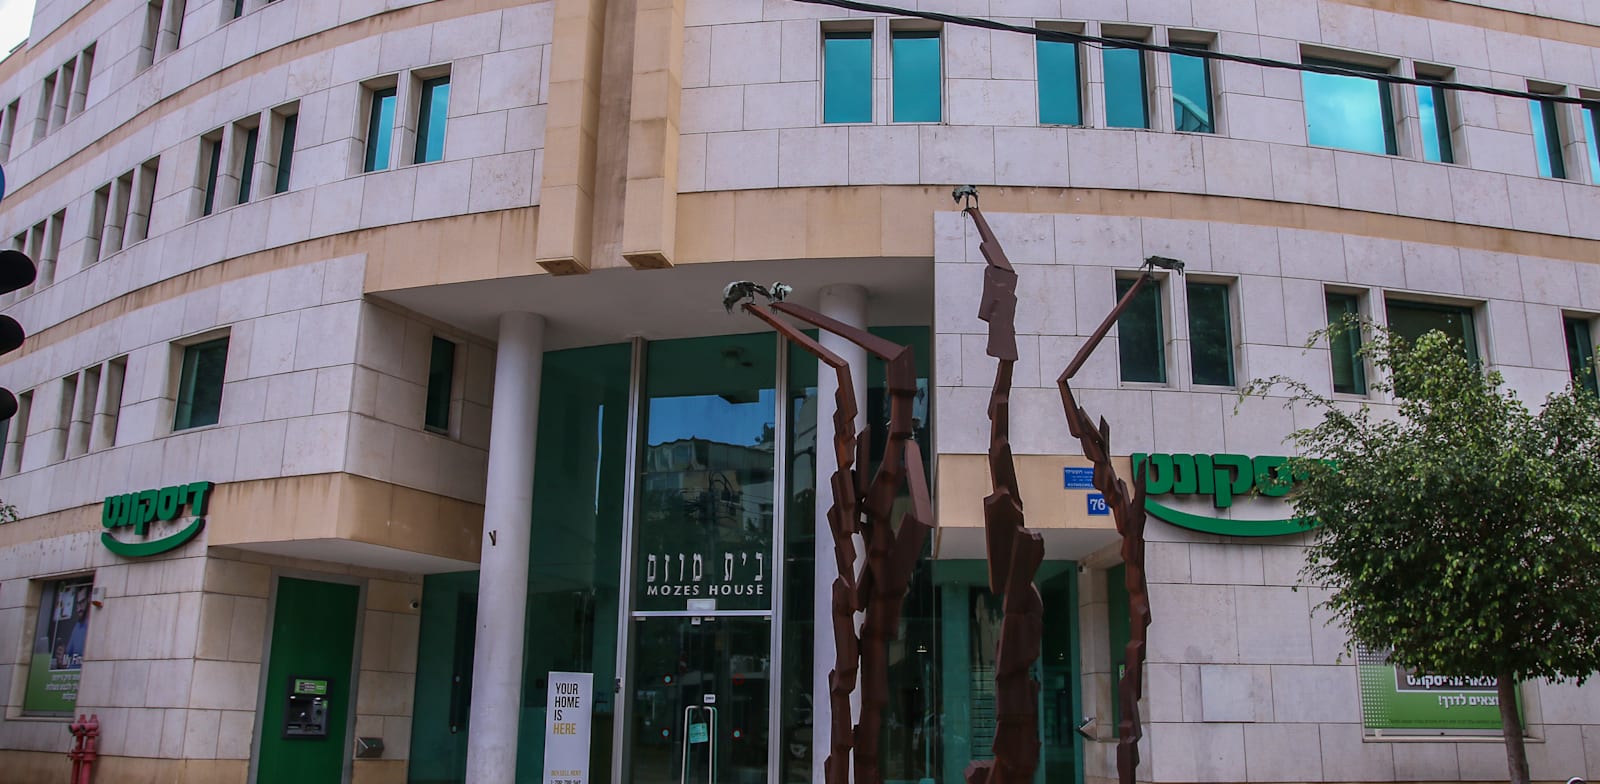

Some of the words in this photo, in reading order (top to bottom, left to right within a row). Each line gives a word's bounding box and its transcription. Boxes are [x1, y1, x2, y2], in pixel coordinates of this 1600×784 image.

[102, 481, 212, 536] דיסקונט
[1090, 498, 1106, 511] 76
[647, 585, 700, 596] MOZES
[709, 584, 765, 596] HOUSE
[555, 683, 579, 695] YOUR
[554, 696, 580, 708] HOME
[1438, 693, 1467, 709] לדרך!
[553, 709, 563, 721] IS
[552, 722, 577, 735] HERE
